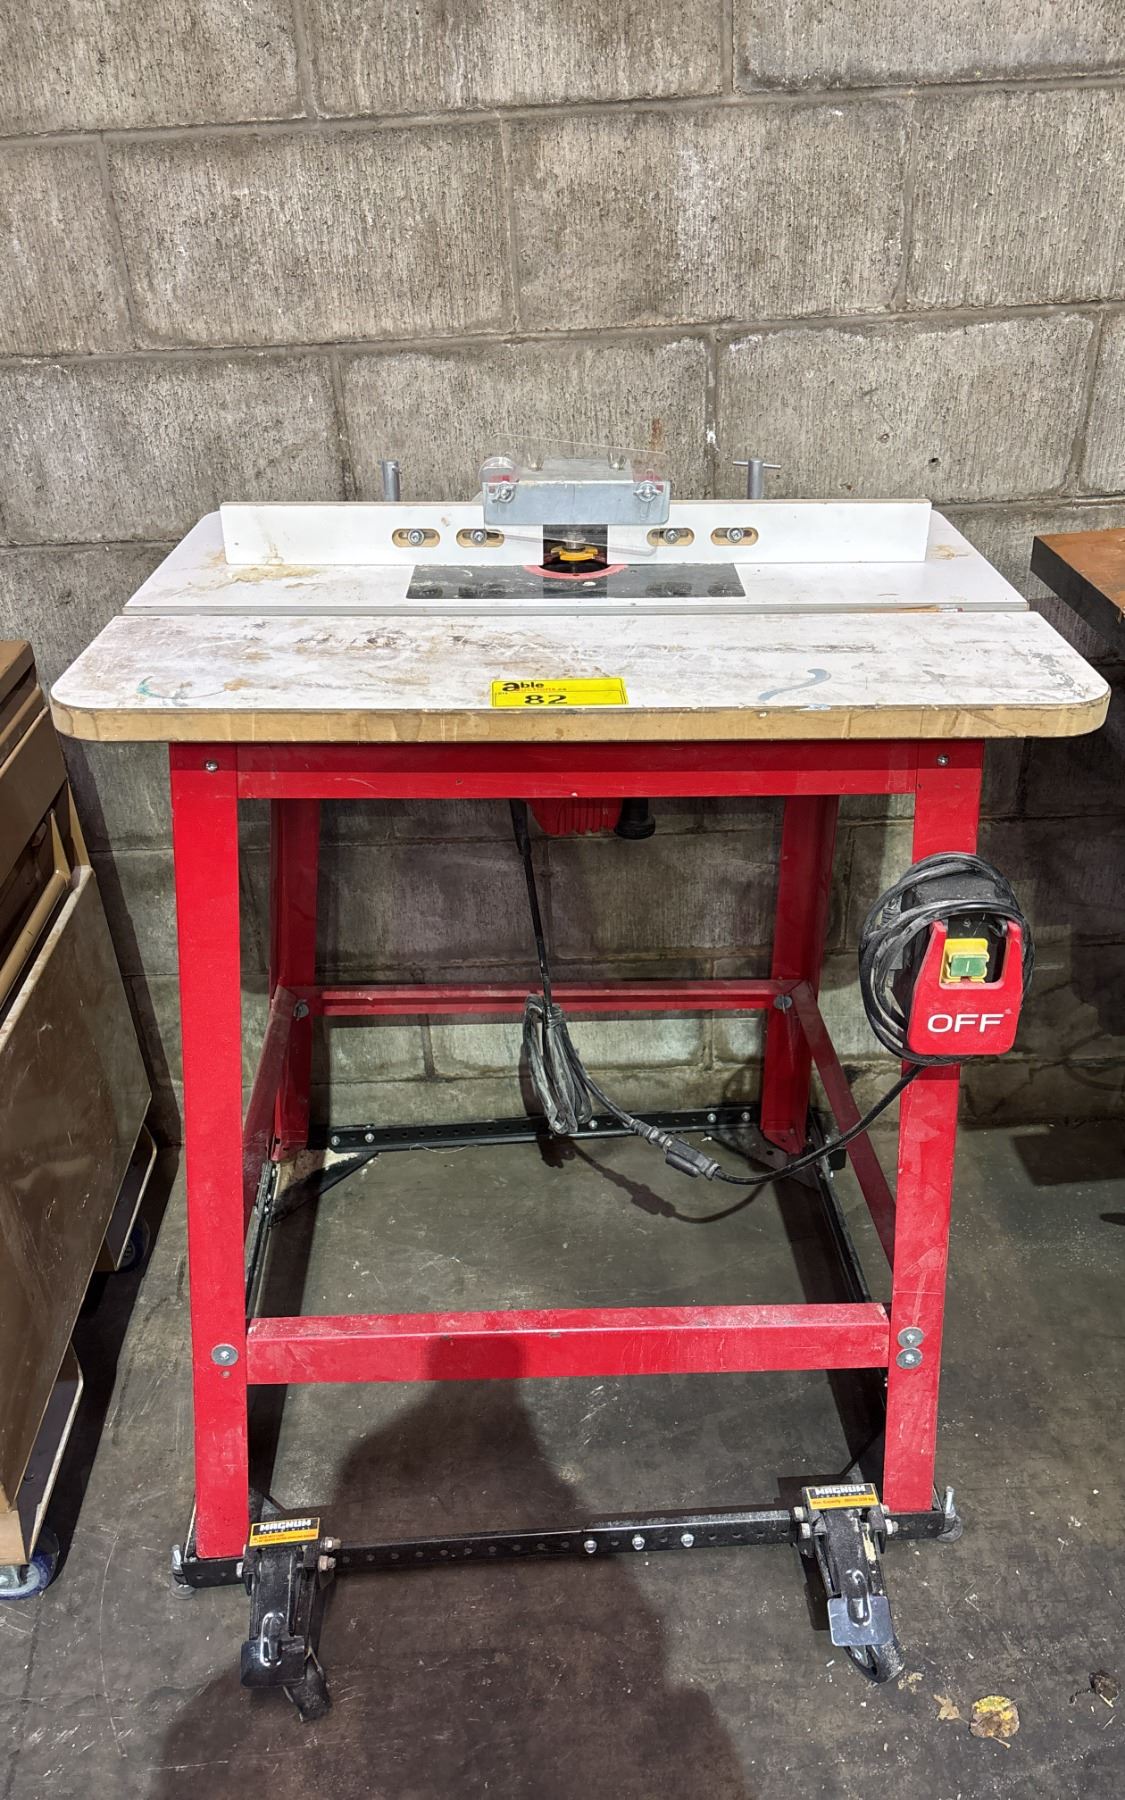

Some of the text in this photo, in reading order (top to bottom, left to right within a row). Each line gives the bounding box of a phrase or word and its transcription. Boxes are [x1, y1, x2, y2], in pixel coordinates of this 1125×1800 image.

[502, 681, 544, 692] able
[524, 694, 568, 705] 82
[927, 1013, 1005, 1033] OFF
[814, 1485, 866, 1495] MAGNUM
[259, 1519, 312, 1532] MAGNUM
